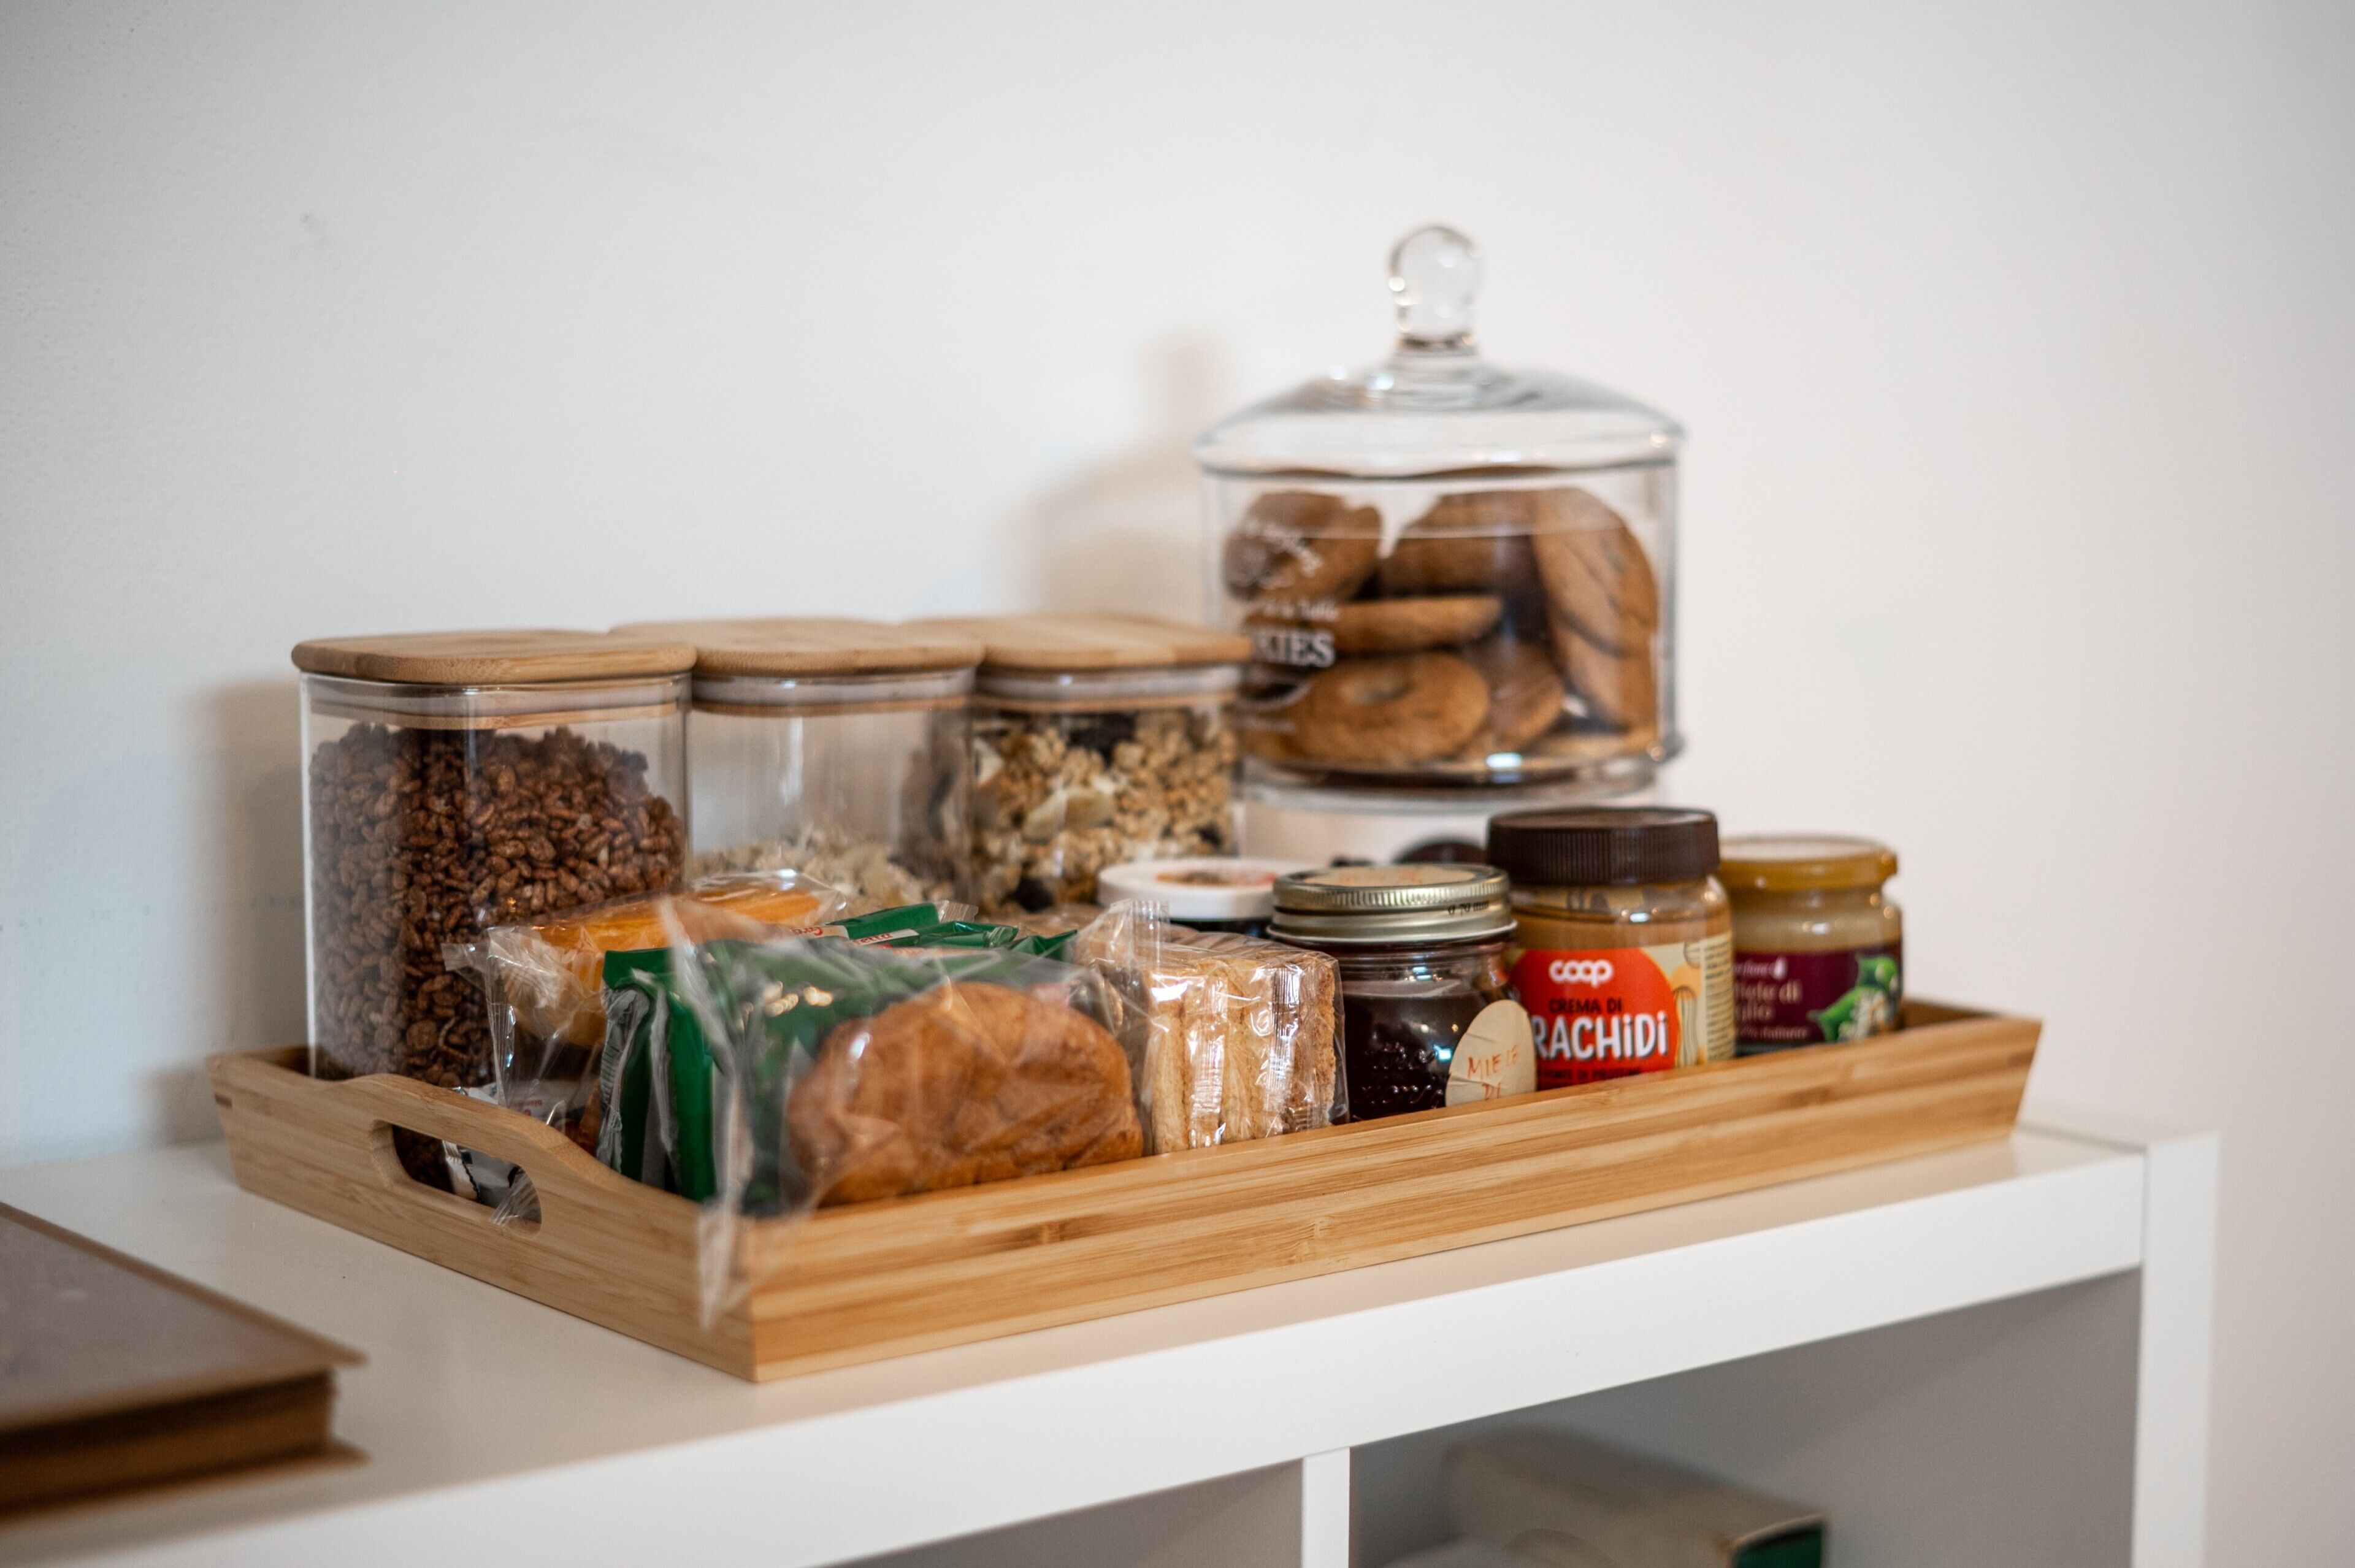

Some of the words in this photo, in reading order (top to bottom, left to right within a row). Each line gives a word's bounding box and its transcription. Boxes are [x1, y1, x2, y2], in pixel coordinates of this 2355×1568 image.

[1549, 959, 1614, 989] coop
[1549, 998, 1601, 1013] CREMA
[1606, 997, 1622, 1011] DI
